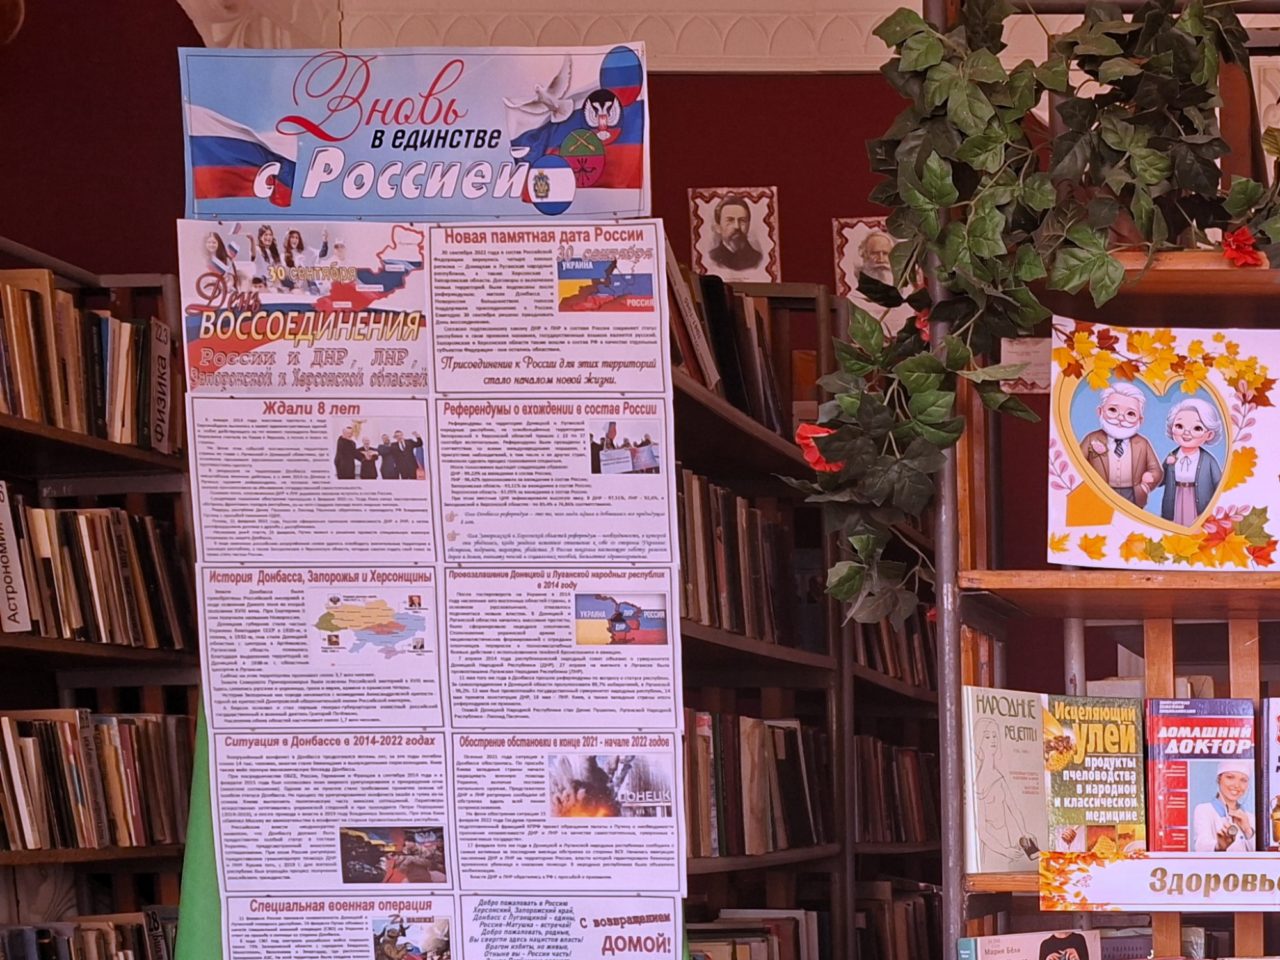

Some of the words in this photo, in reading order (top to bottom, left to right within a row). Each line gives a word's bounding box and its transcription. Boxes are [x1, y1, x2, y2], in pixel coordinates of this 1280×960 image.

[275, 50, 469, 142] Вновь
[371, 129, 384, 149] в
[391, 129, 502, 150] единстве
[253, 162, 282, 199] с
[302, 145, 531, 199] Россией
[445, 228, 487, 244] Новая
[491, 229, 556, 244] памятная
[559, 229, 591, 245] дата
[594, 226, 644, 242] России
[268, 266, 285, 282] 30
[290, 262, 358, 283] сентября
[186, 271, 262, 314] День
[200, 310, 422, 348] ВОССОЕДИНЕНИЯ
[201, 347, 276, 366] России
[287, 350, 300, 366] и
[441, 355, 513, 373] Присоединение
[522, 355, 557, 369] России
[155, 356, 169, 442] Физика
[262, 400, 313, 416] Ждали
[317, 401, 326, 415] 8
[329, 402, 361, 415] лет
[443, 401, 511, 419] Референдумы
[513, 405, 520, 415] о
[522, 401, 574, 416] вхождении
[576, 405, 582, 415] в
[584, 404, 621, 415] состав
[622, 401, 657, 415] России
[209, 570, 253, 585] История
[257, 569, 306, 586] Донбасса,
[307, 569, 359, 586] Запорожья
[361, 573, 368, 583] и
[369, 569, 432, 586] Херсонщины
[543, 581, 559, 589] 2014
[560, 582, 578, 591] году
[1054, 701, 1136, 725] Исцеляющий
[1157, 724, 1252, 738] ДОМАШНИЙ
[224, 735, 280, 749] Ситуация
[282, 738, 289, 746] в
[290, 735, 341, 748] Донбассе
[343, 738, 350, 746] в
[353, 735, 404, 746] 2014-2022
[405, 735, 436, 747] годах
[459, 735, 506, 750] Обострение
[507, 735, 551, 747] обстановки
[552, 739, 558, 747] в
[559, 738, 581, 749] конце
[582, 736, 599, 747] 2021
[604, 738, 630, 747] начале
[631, 736, 647, 747] 2022
[649, 736, 670, 747] годов
[1072, 721, 1136, 765] улей
[1164, 739, 1251, 754] ДОКТОР
[1085, 757, 1137, 772] продукты
[1062, 770, 1137, 783] пчеловодства
[1076, 785, 1083, 794] в
[1085, 782, 1137, 796] народной
[1054, 799, 1062, 807] и
[1064, 795, 1138, 808] классической
[1085, 811, 1138, 823] медицине
[249, 899, 325, 915] Специальная
[328, 901, 376, 912] военная
[379, 900, 433, 915] операция
[579, 917, 588, 929] С
[593, 912, 671, 929] возвращением
[601, 932, 672, 957] ДОМОЙ!
